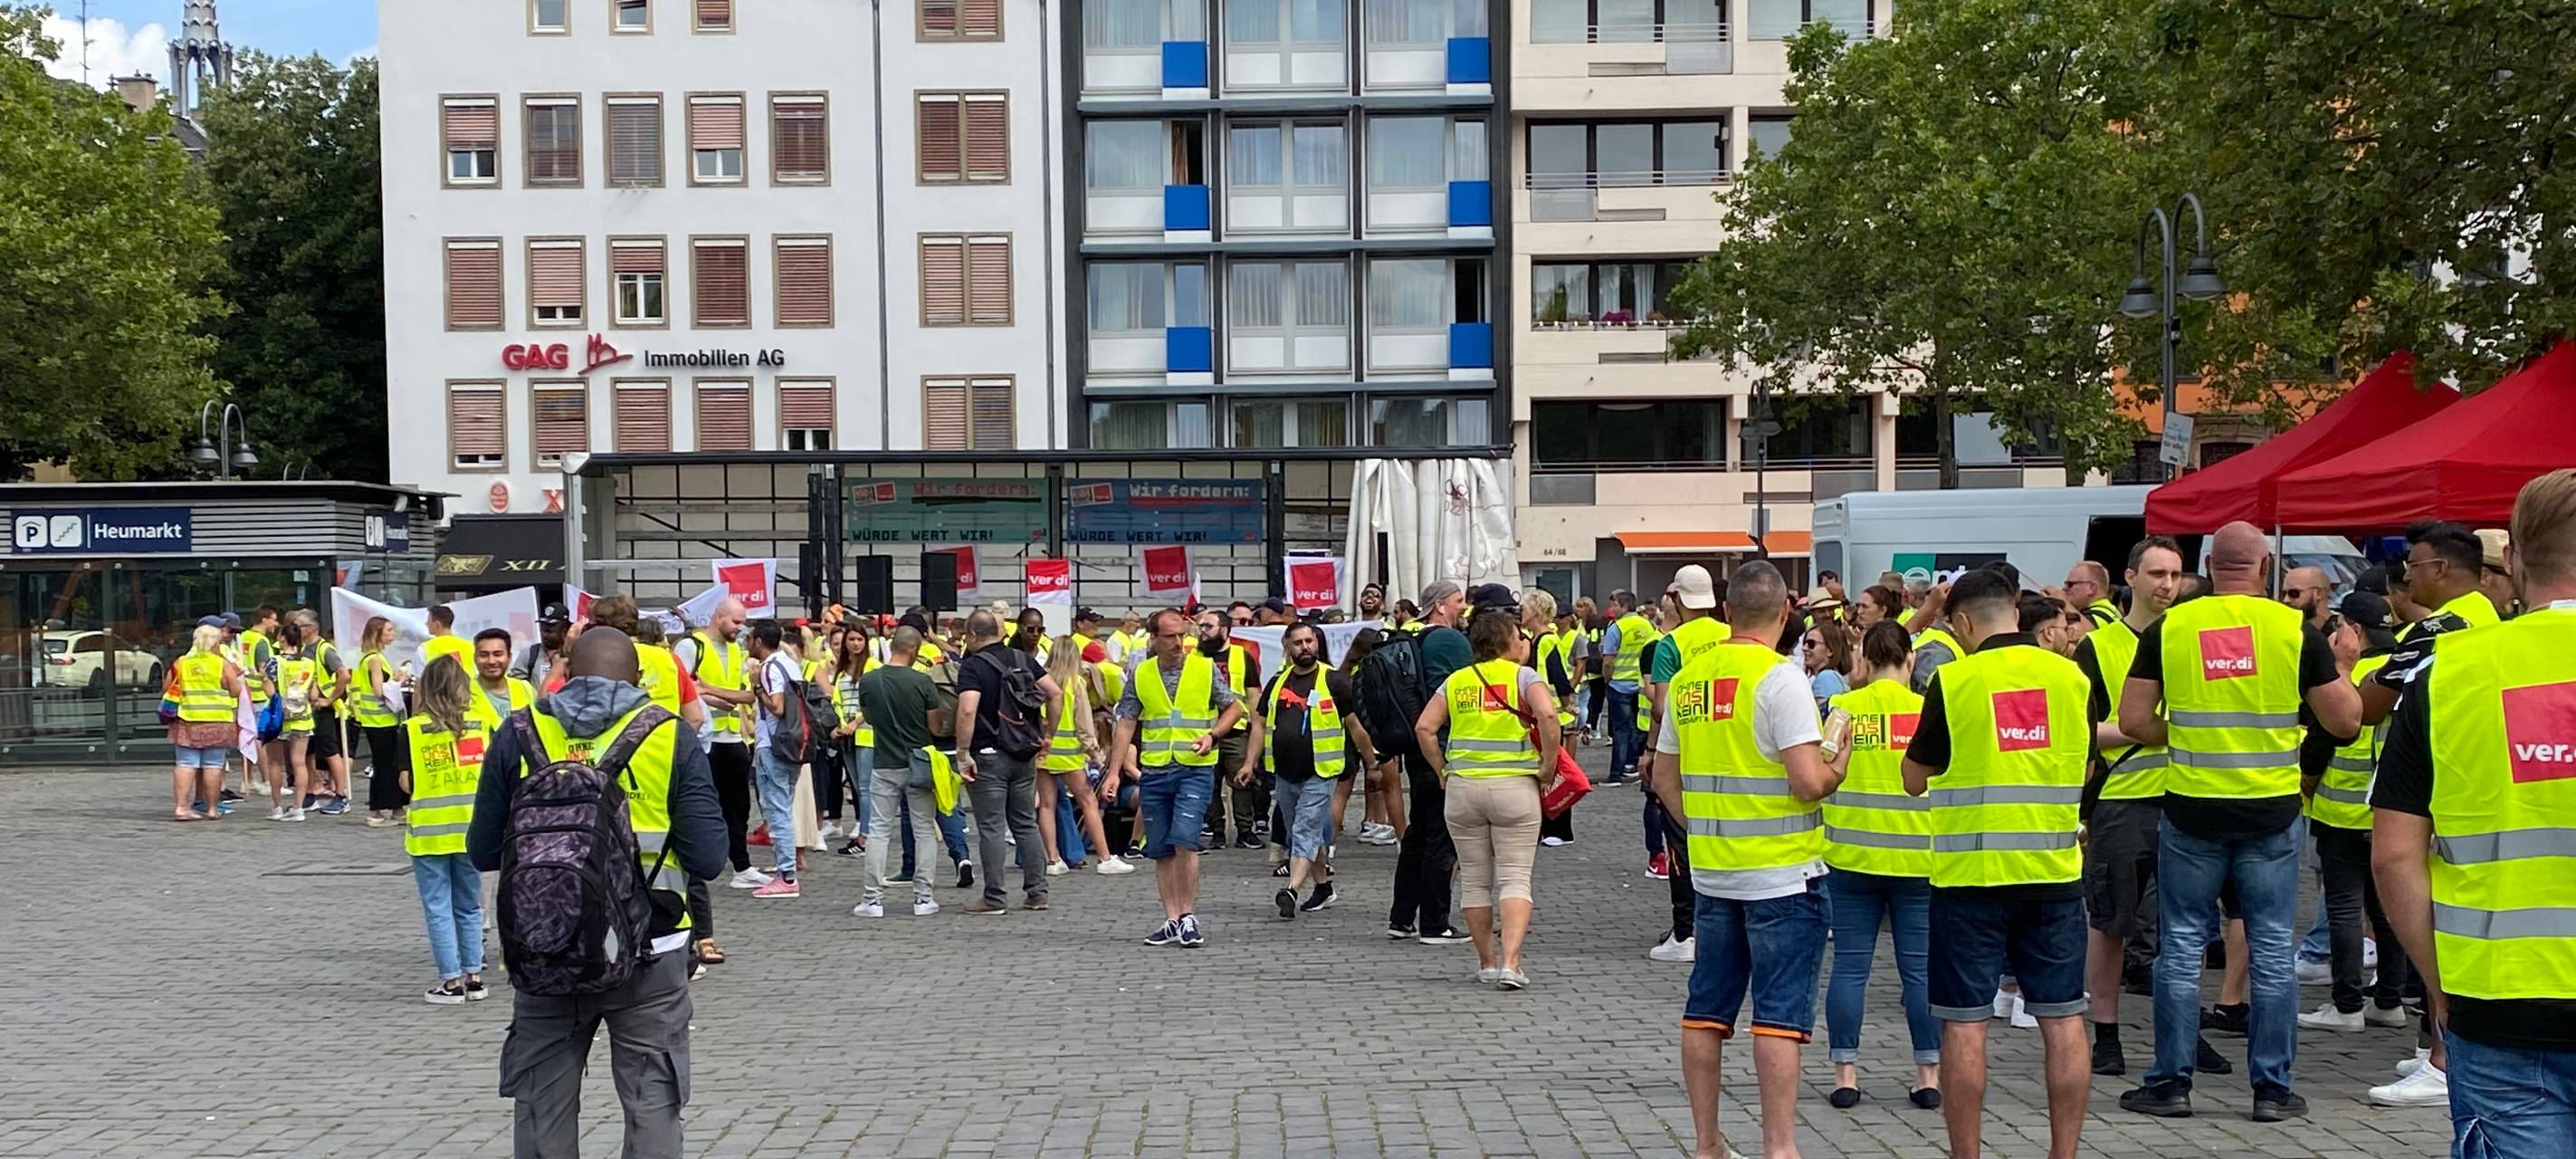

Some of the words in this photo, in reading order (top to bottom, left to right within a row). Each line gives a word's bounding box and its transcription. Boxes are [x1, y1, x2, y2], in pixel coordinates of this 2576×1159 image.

[501, 344, 568, 370] GAG
[644, 350, 750, 368] Immobilien
[757, 349, 785, 368] AG
[1129, 482, 1163, 497] Wir
[1169, 484, 1250, 497] fordern:
[94, 522, 183, 539] Heumarkt
[853, 528, 900, 541] WÜRDE
[911, 530, 949, 541] WERT
[959, 530, 994, 541] WIR!
[1069, 528, 1116, 542] WÜRDE
[1126, 531, 1164, 542] WERT
[1174, 531, 1207, 542] WIR!
[2205, 656, 2253, 671] ver.di
[1850, 714, 1879, 723] HNE
[1853, 733, 1880, 744] EIN
[1999, 724, 2046, 742] ver.di
[2514, 742, 2576, 763] ver.
